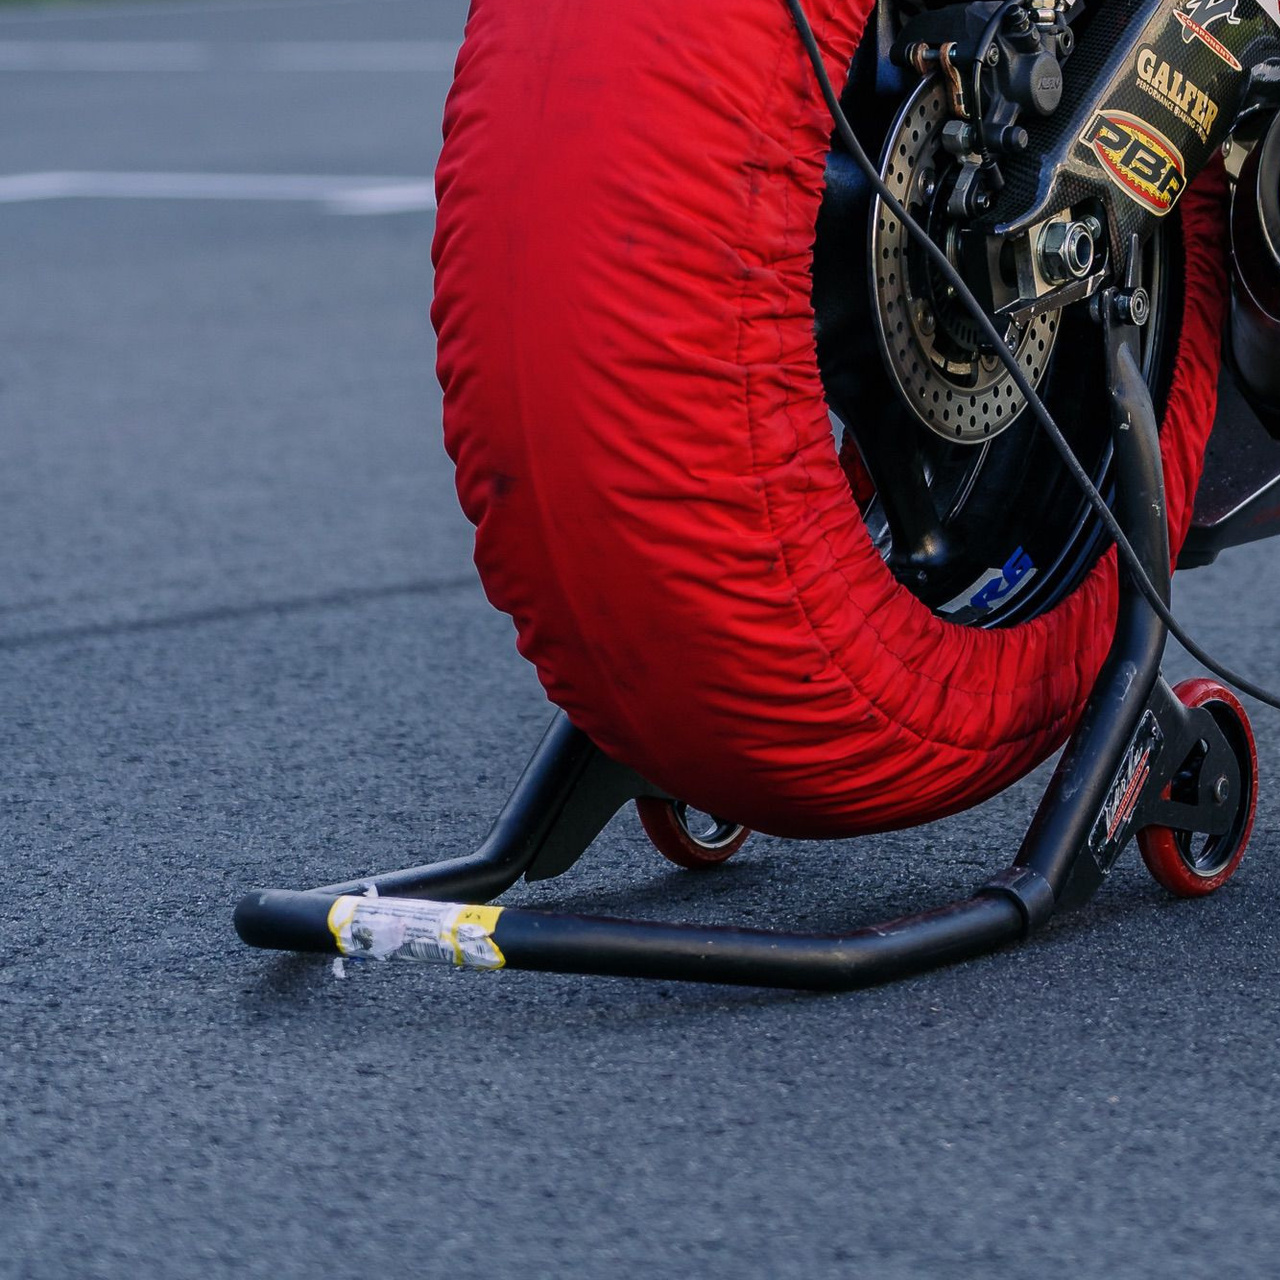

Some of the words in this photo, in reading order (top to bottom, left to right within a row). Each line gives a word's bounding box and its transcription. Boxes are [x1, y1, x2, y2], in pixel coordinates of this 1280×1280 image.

[1179, 12, 1238, 67] COMPONENTS
[1135, 77, 1175, 111] PERFORMANCE
[1136, 47, 1219, 136] GALFER
